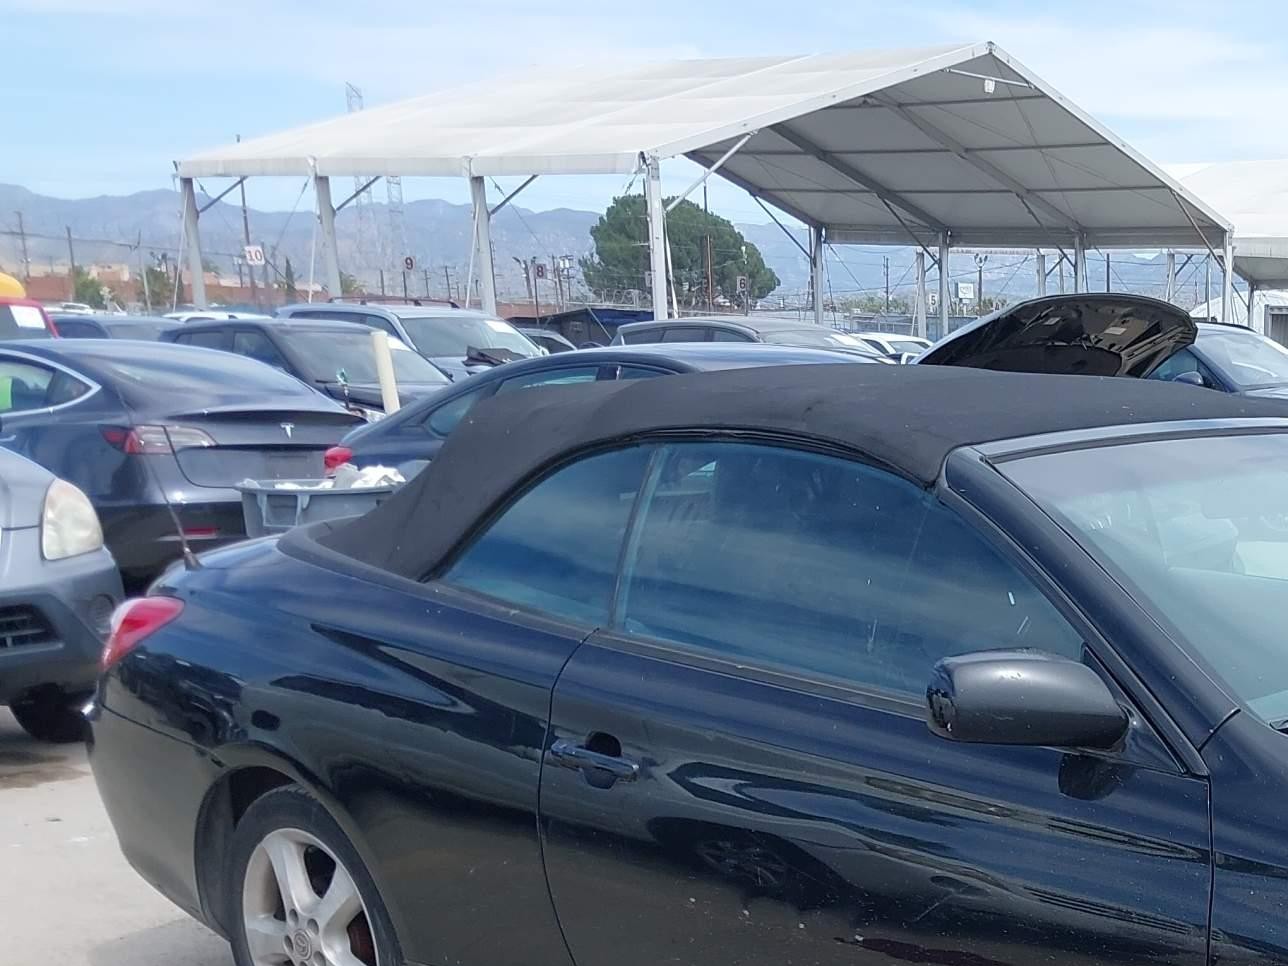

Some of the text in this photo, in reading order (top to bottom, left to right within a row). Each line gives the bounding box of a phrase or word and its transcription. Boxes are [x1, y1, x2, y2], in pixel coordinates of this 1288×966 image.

[247, 250, 263, 261] 10
[405, 256, 413, 270] 9
[536, 265, 544, 278] 8
[740, 278, 746, 289] 6
[931, 295, 936, 305] 5
